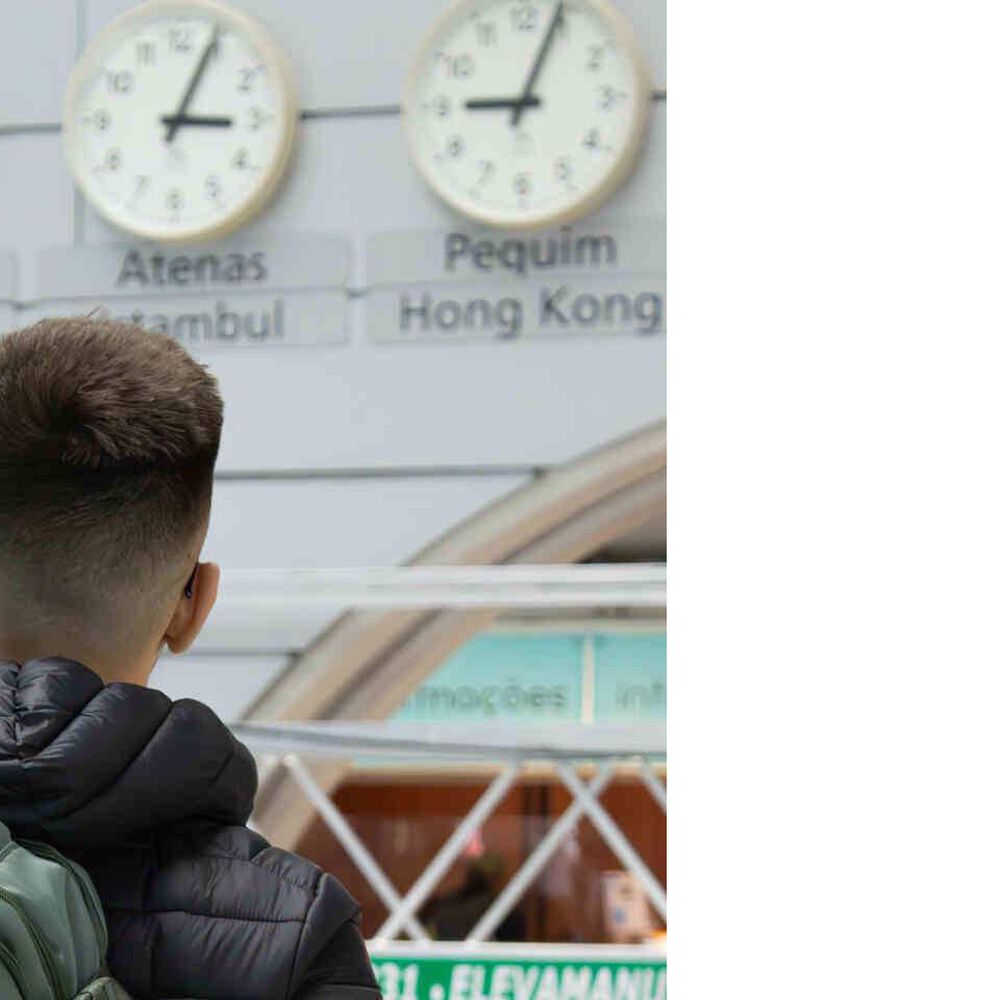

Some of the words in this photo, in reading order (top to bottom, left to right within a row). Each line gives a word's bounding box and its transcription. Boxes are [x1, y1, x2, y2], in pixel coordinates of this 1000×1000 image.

[116, 247, 269, 287] Atenas
[443, 225, 617, 274] Pequim
[401, 293, 523, 338] Hong
[538, 286, 663, 336] Kong
